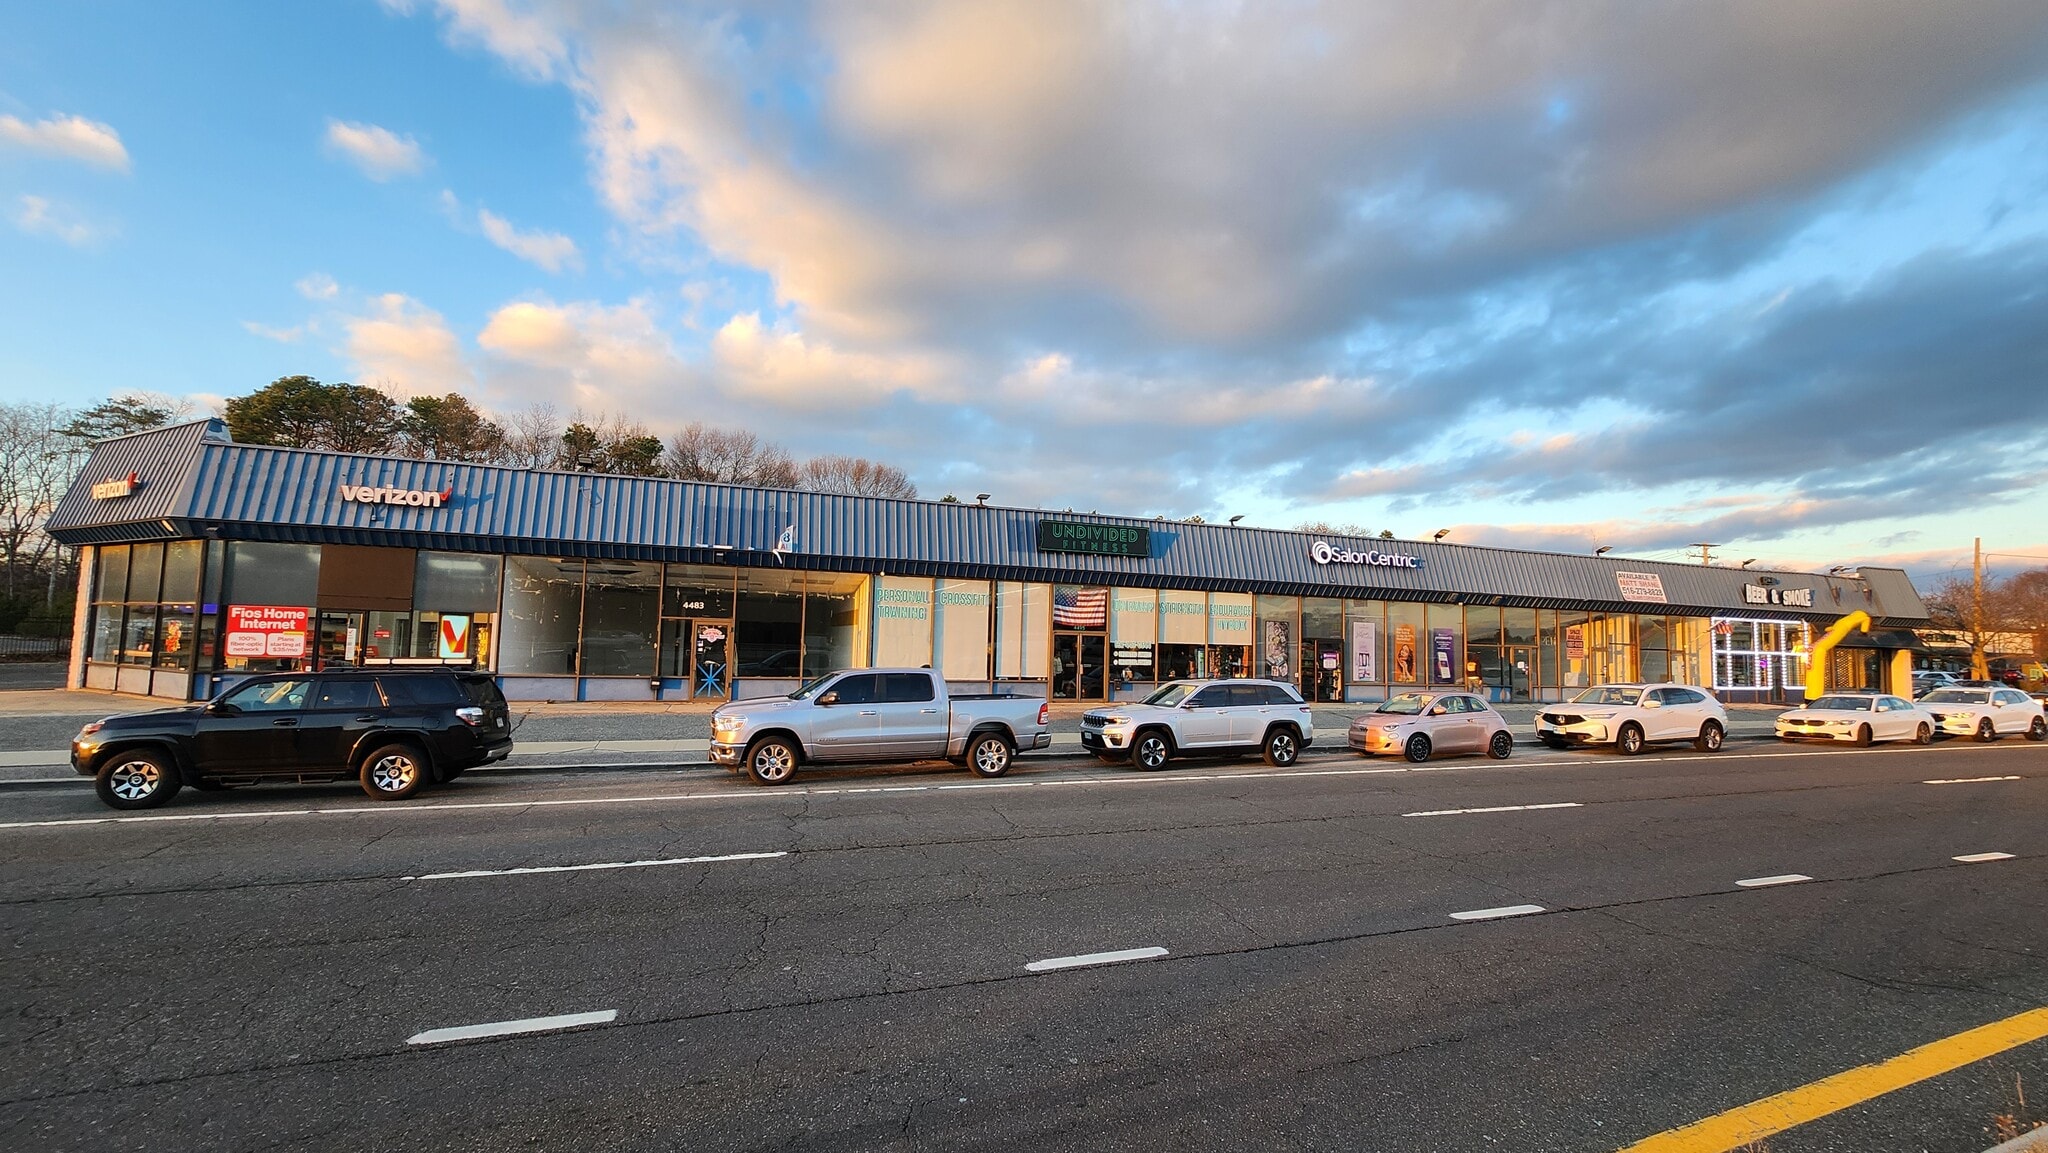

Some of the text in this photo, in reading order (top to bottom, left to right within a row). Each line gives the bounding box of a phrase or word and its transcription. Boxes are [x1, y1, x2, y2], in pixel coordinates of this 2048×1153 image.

[92, 479, 129, 499] verizon
[341, 484, 441, 507] verizon
[1052, 523, 1138, 543] UNDIVIDED
[1062, 539, 1128, 553] FITNESS
[1331, 547, 1417, 568] SalonCentric
[877, 588, 930, 604] PERSONAL
[940, 592, 986, 605] CROSSFIT
[1745, 584, 1769, 604] BEER
[1782, 588, 1811, 607] SMOKE
[231, 607, 306, 620] Fios Home
[683, 602, 705, 610] 4483
[878, 605, 927, 620] TRAINING
[1209, 604, 1252, 616] ENDURANCE
[240, 618, 297, 630] Internet
